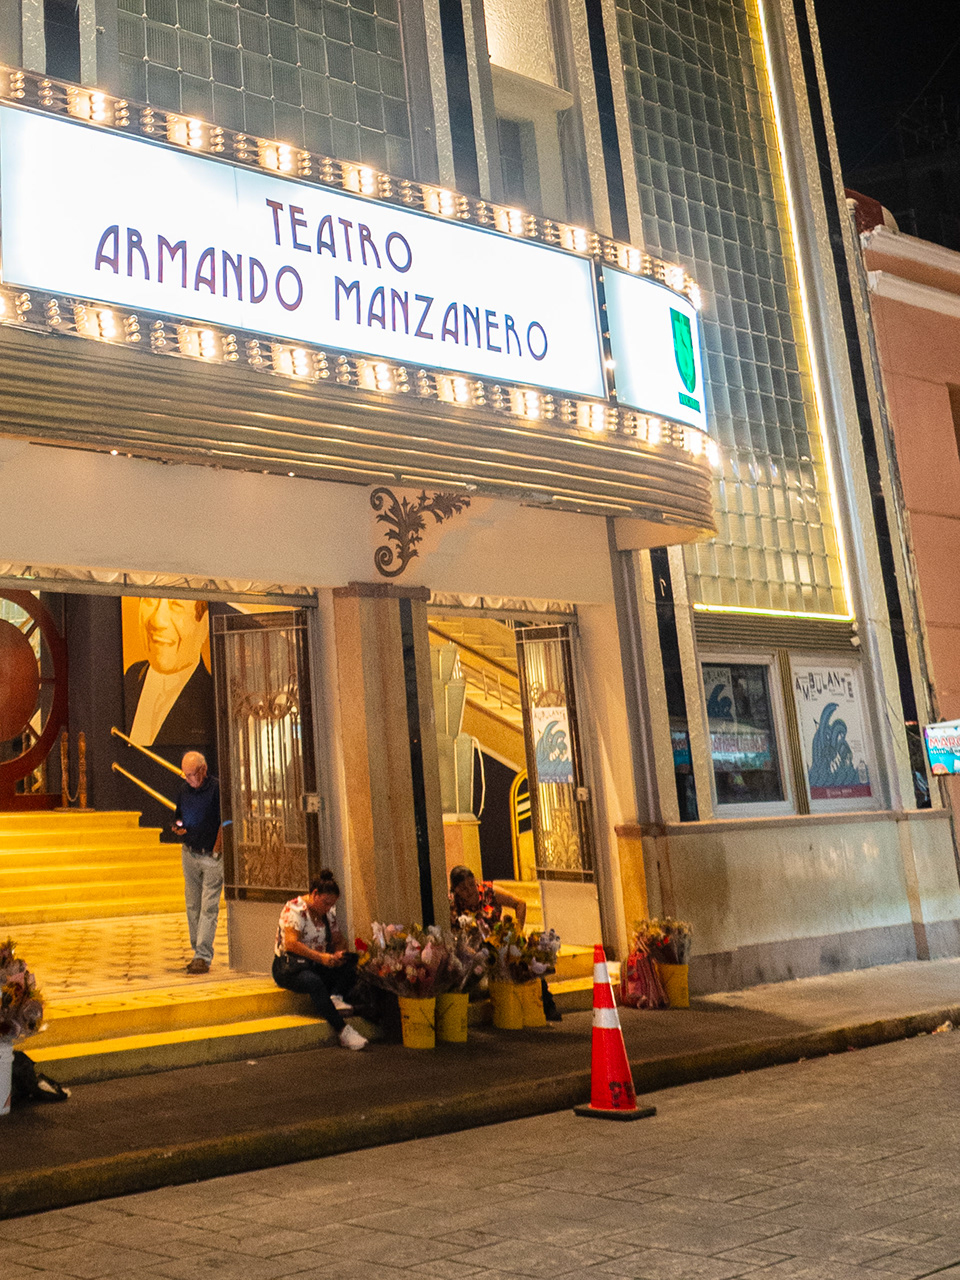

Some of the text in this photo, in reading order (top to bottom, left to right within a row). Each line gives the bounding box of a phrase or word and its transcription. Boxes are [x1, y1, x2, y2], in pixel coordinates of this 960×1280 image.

[265, 198, 413, 273] TEATRO
[94, 224, 548, 361] ARMANDO MANZANERO
